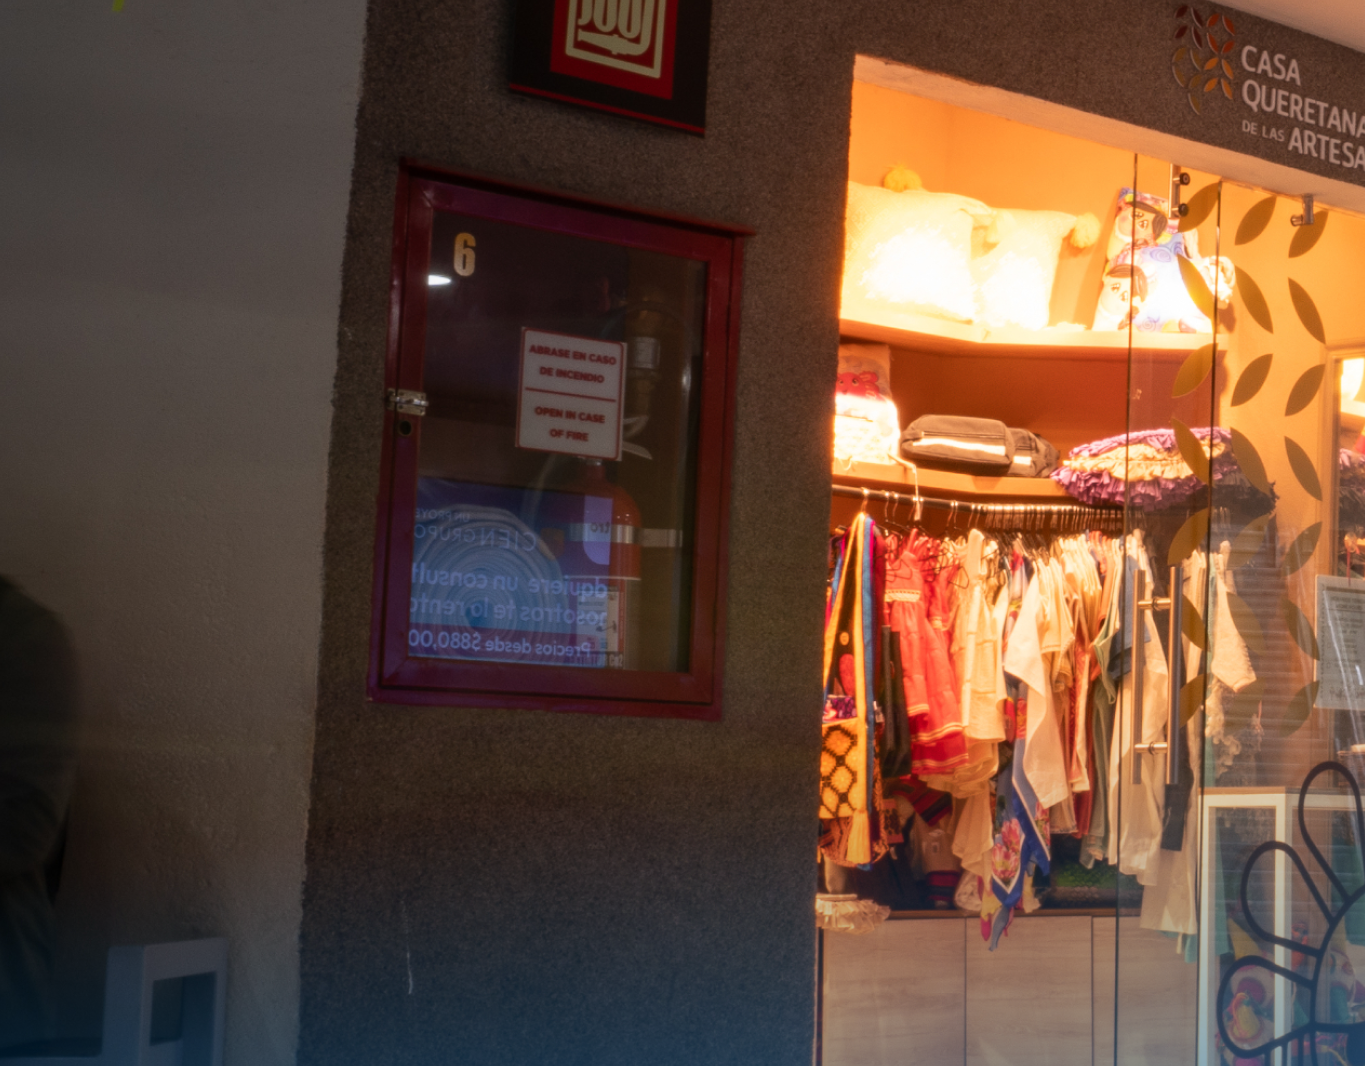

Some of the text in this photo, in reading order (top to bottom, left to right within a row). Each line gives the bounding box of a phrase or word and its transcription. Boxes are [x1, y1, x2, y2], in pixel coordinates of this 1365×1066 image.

[1241, 45, 1301, 86] CASA
[1242, 119, 1258, 135] DE
[1262, 125, 1285, 142] LAS
[453, 232, 476, 277] 6
[529, 344, 617, 365] ABRASE EN CASO
[539, 366, 605, 383] DE INCENDIO
[534, 406, 605, 424] OPEN IN CASE
[549, 428, 589, 442] OF FIRE
